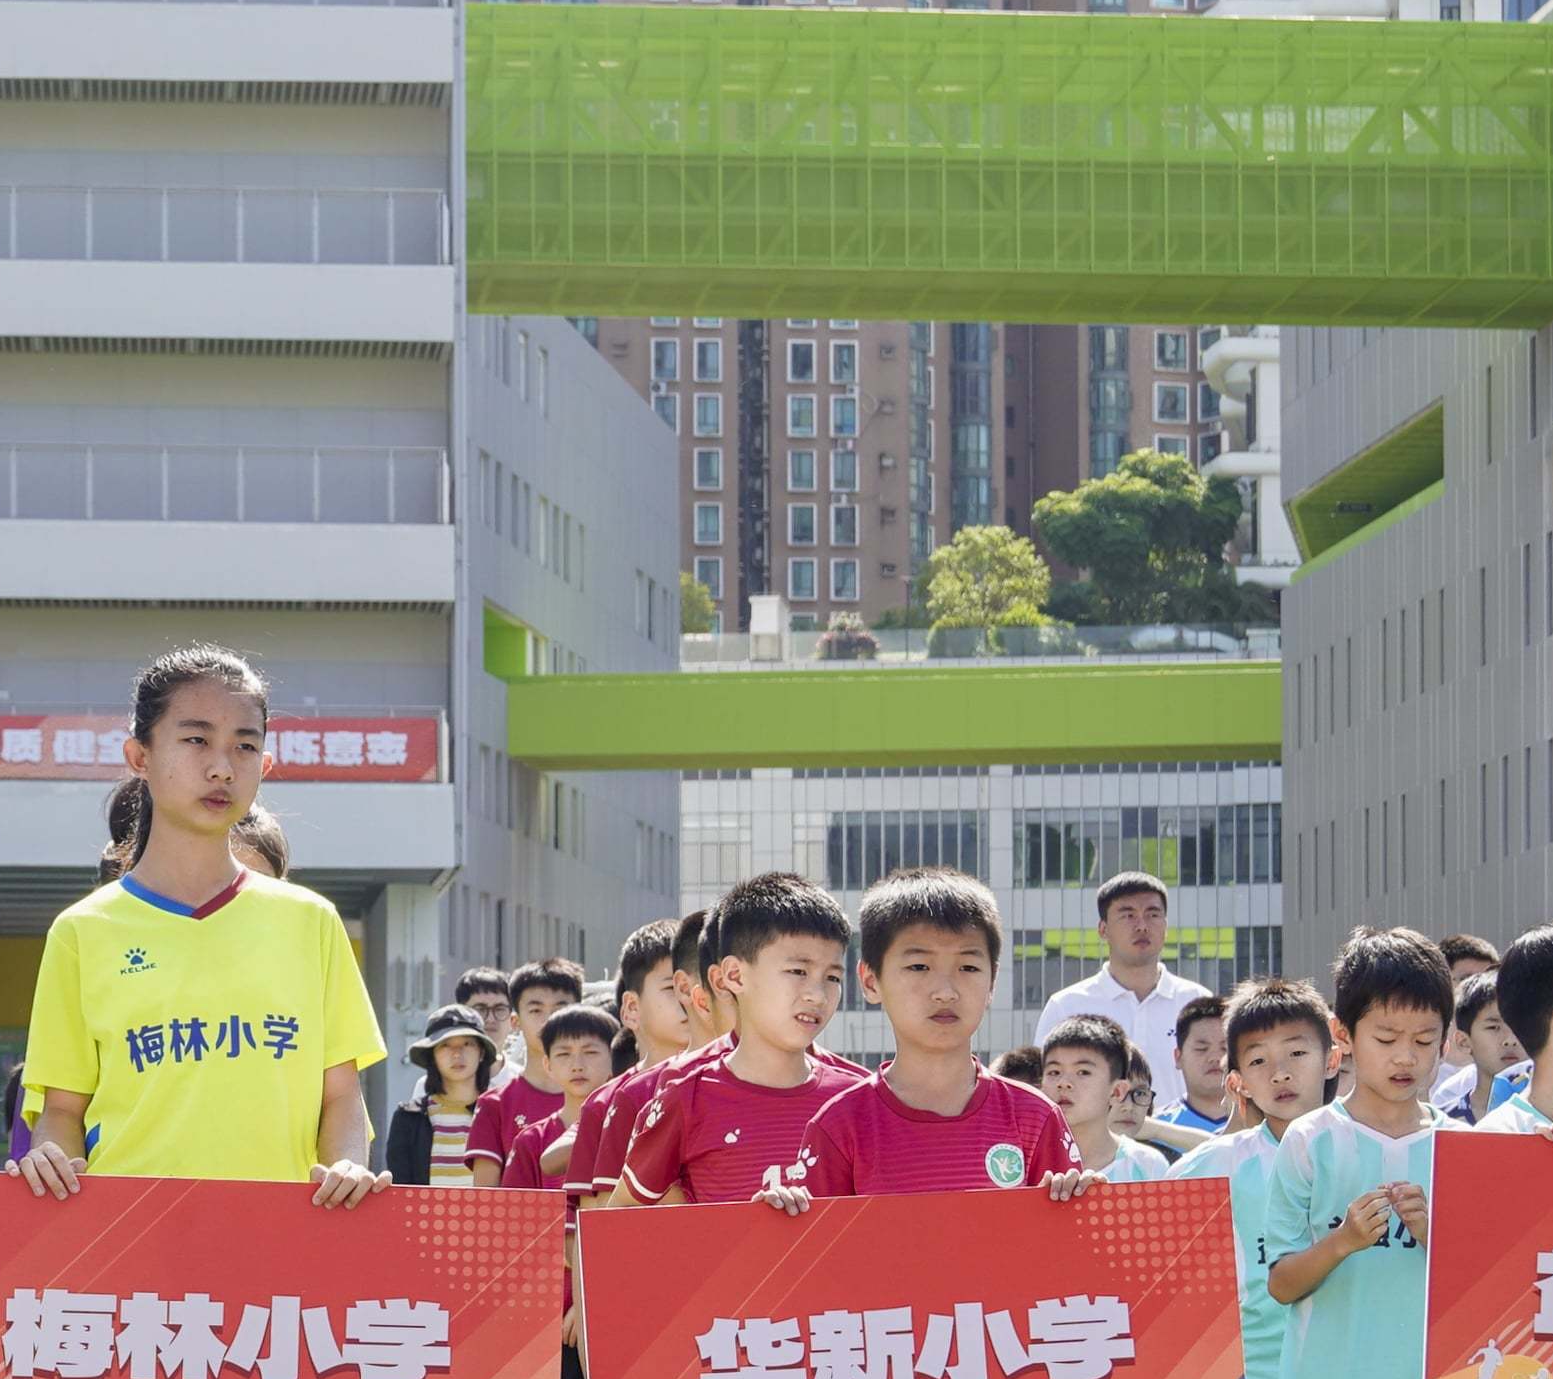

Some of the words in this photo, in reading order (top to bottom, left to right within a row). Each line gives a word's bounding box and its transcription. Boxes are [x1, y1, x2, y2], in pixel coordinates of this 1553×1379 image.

[120, 963, 157, 975] KELME
[126, 1014, 299, 1073] 梅林小学
